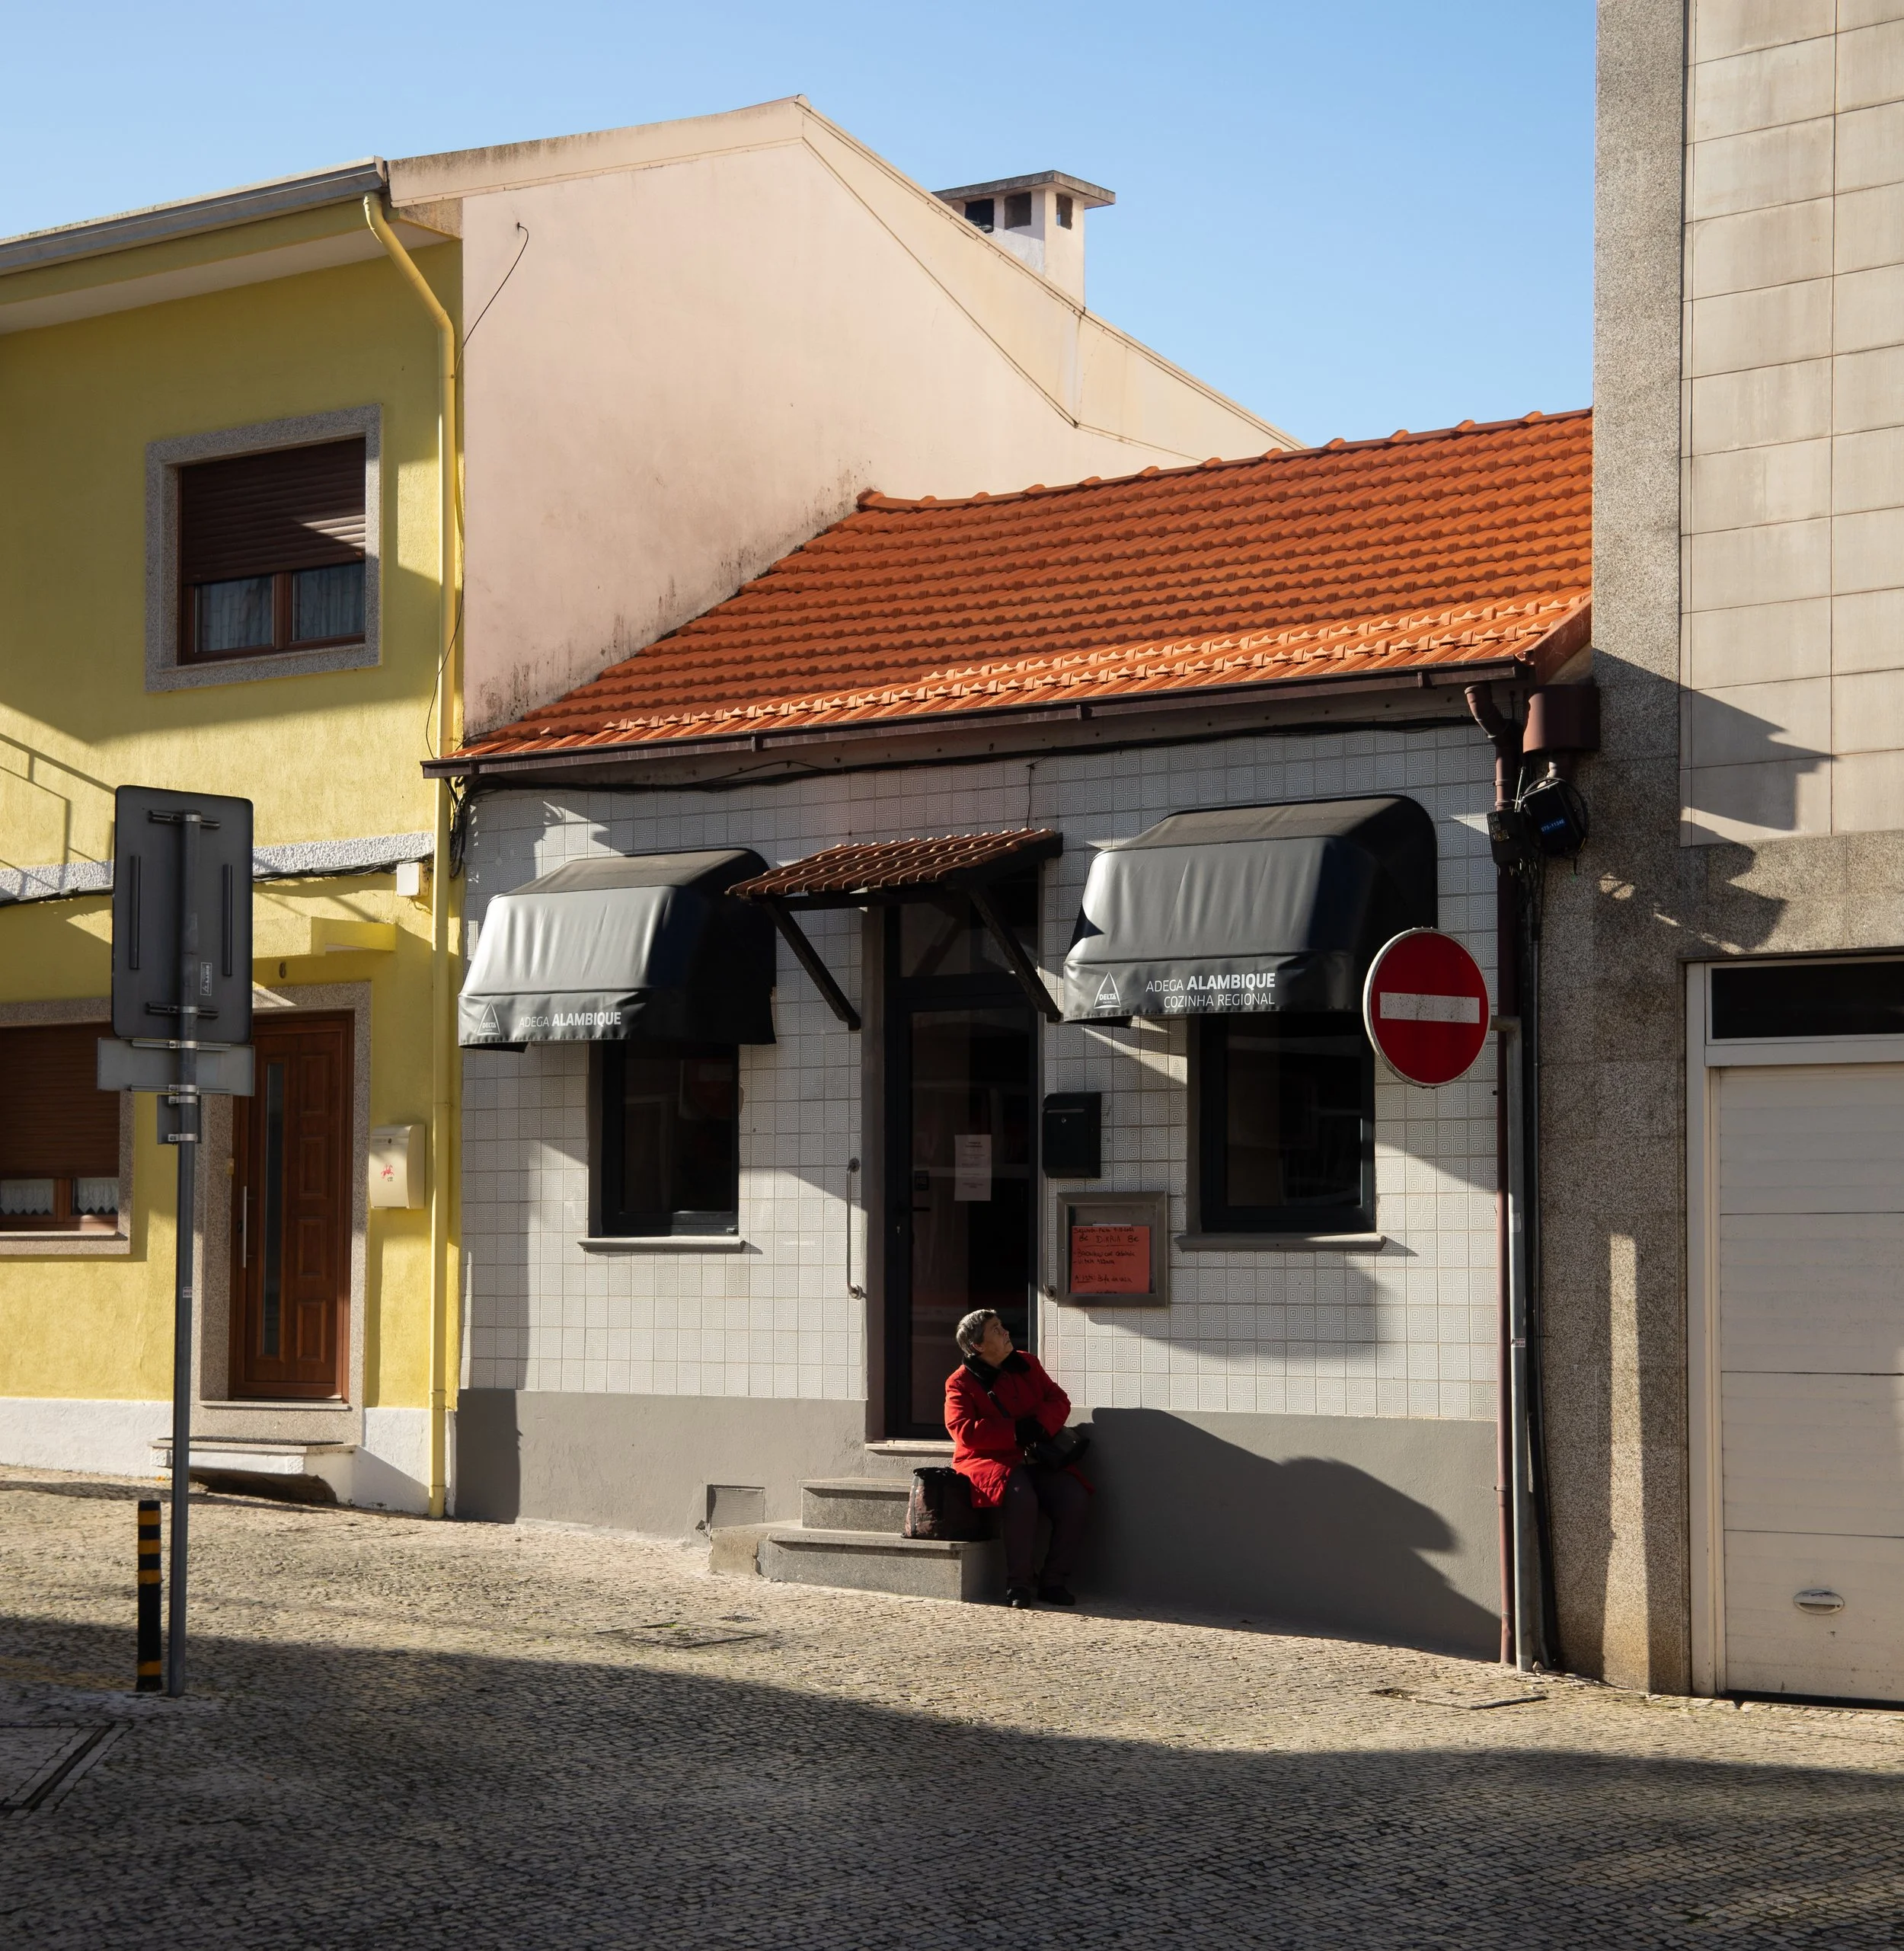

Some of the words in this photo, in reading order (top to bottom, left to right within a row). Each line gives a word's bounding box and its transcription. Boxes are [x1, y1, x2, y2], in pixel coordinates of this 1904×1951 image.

[1145, 979, 1184, 993] ADEGA
[1187, 972, 1276, 991] ALAMBIQUE
[1164, 994, 1214, 1008] COZINHA
[1218, 992, 1275, 1006] REGIONAL
[519, 1016, 549, 1028] ADEGA
[551, 1011, 621, 1027] ALAMBIQUE
